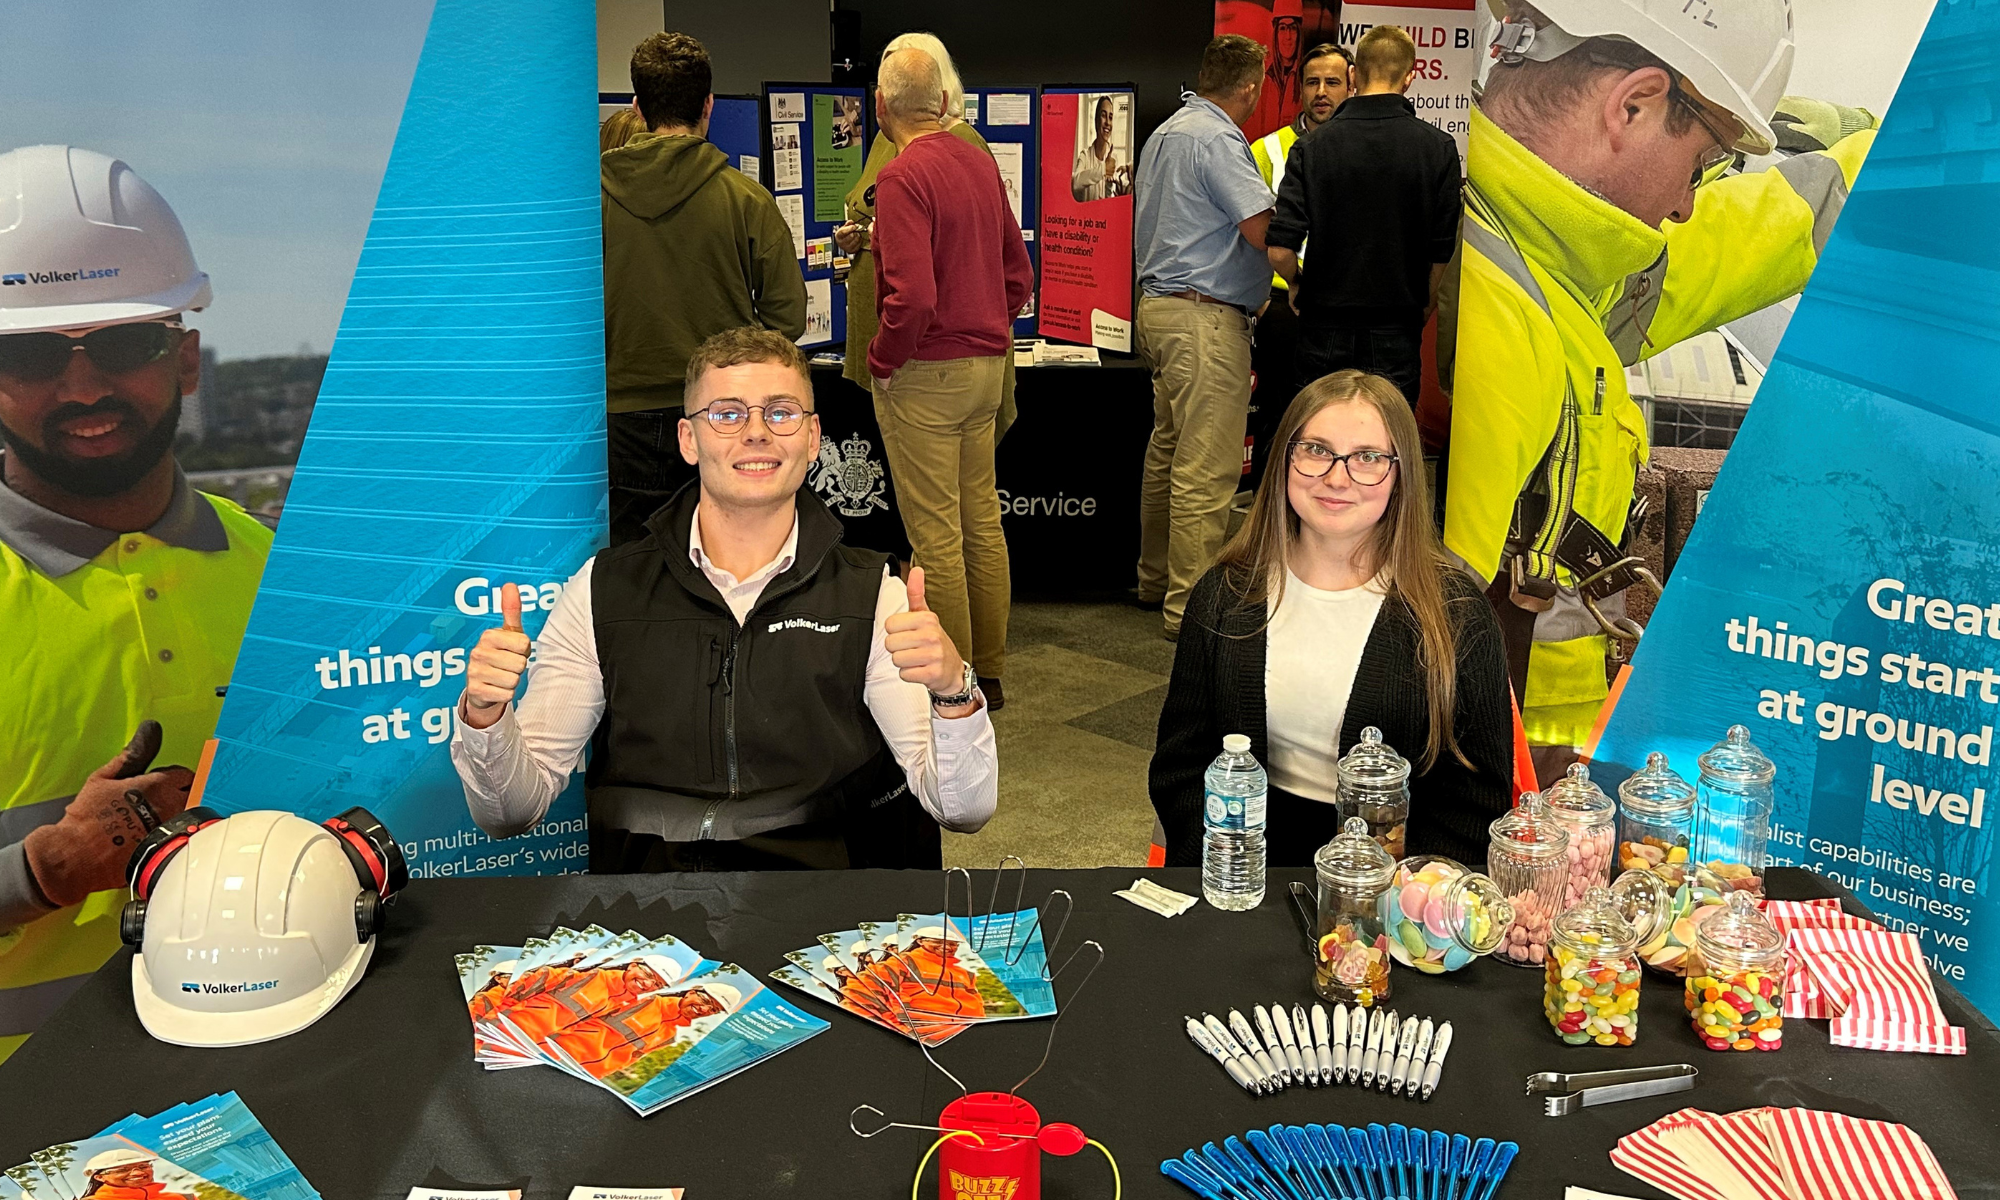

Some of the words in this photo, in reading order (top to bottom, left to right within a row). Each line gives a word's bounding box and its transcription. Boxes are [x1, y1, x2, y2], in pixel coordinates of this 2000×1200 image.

[1045, 214, 1067, 227] Looking
[1069, 216, 1077, 226] for
[1083, 217, 1093, 229] job
[1095, 219, 1106, 229] and
[1045, 228, 1058, 238] have
[1059, 231, 1063, 239] a
[1064, 230, 1091, 244] disability
[1092, 235, 1099, 243] or
[1044, 242, 1062, 253] health
[1063, 245, 1094, 257] condition?
[28, 267, 120, 285] VolkerLaser
[996, 489, 1097, 517] Service
[455, 576, 571, 616] Grea
[1867, 578, 2000, 640] Great
[784, 618, 841, 633] VolkerLaser
[315, 646, 466, 690] things
[1725, 616, 1870, 680] things
[1880, 650, 2000, 704] start
[362, 708, 411, 744] at
[1757, 688, 1805, 724] at
[1815, 700, 1993, 766] ground
[1870, 763, 1985, 829] level
[540, 842, 589, 862] wide
[1809, 837, 1933, 882] capabilities
[1938, 872, 1976, 894] are
[1869, 877, 1971, 926] business;
[1934, 929, 1969, 952] we
[202, 979, 279, 994] VolkerLaser
[159, 1132, 174, 1140] Set
[175, 1125, 195, 1135] your
[163, 1131, 194, 1146] exceed
[196, 1123, 215, 1133] your
[167, 1127, 223, 1151] expectations
